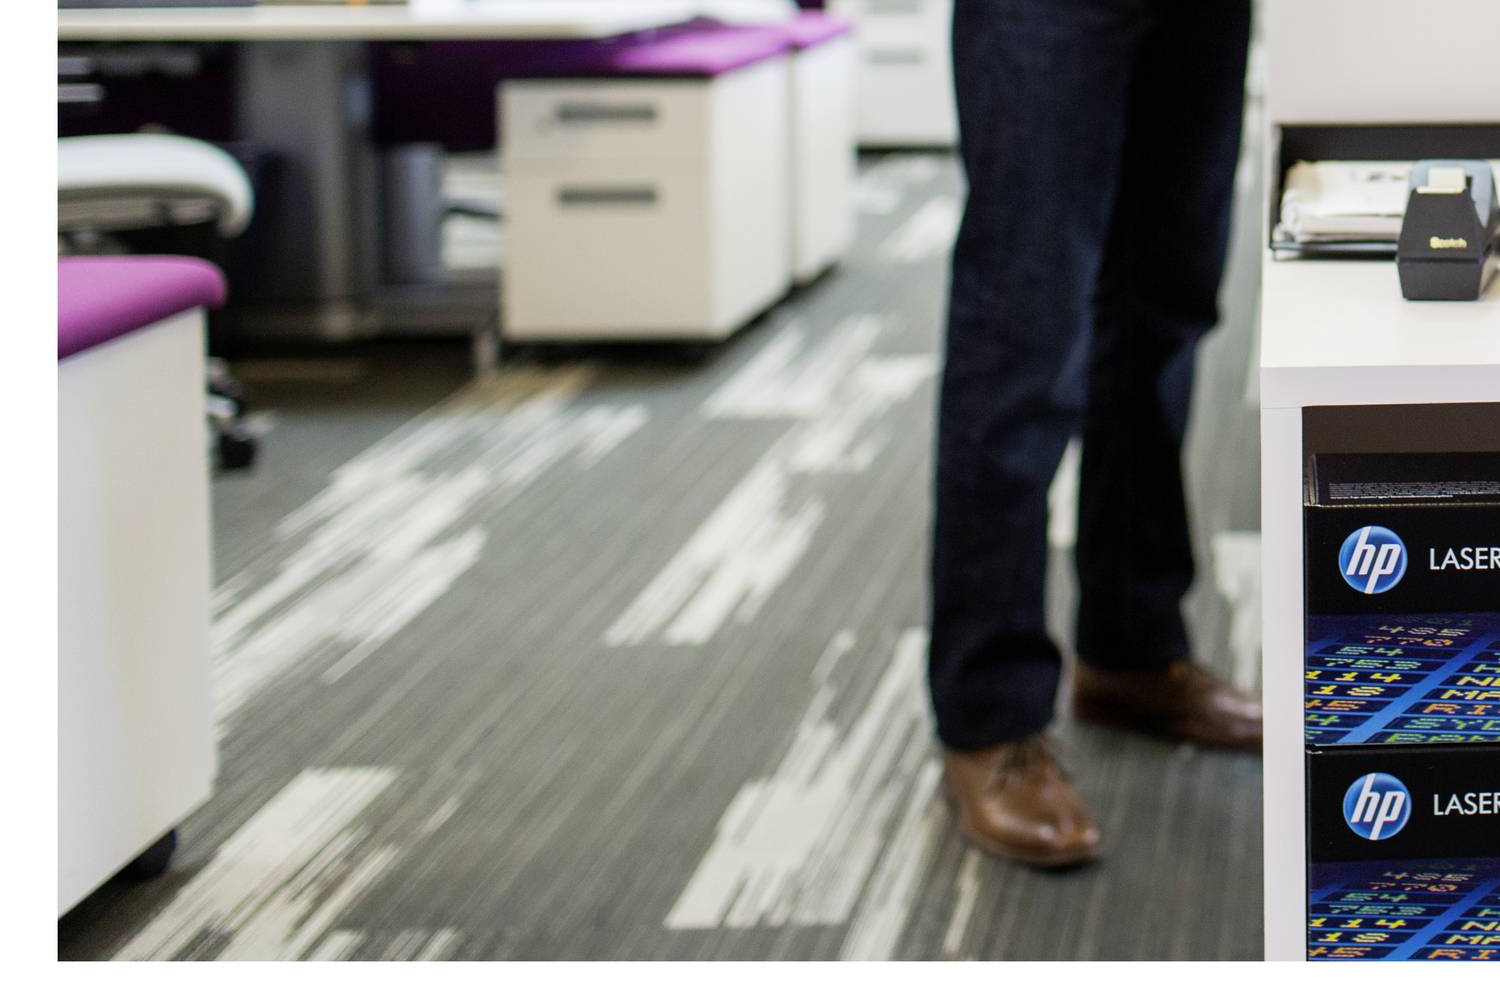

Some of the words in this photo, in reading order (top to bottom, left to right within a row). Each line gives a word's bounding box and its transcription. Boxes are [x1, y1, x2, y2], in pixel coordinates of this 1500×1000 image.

[1430, 236, 1467, 249] Scotch
[1345, 526, 1402, 594] hp
[1350, 773, 1406, 840] hp
